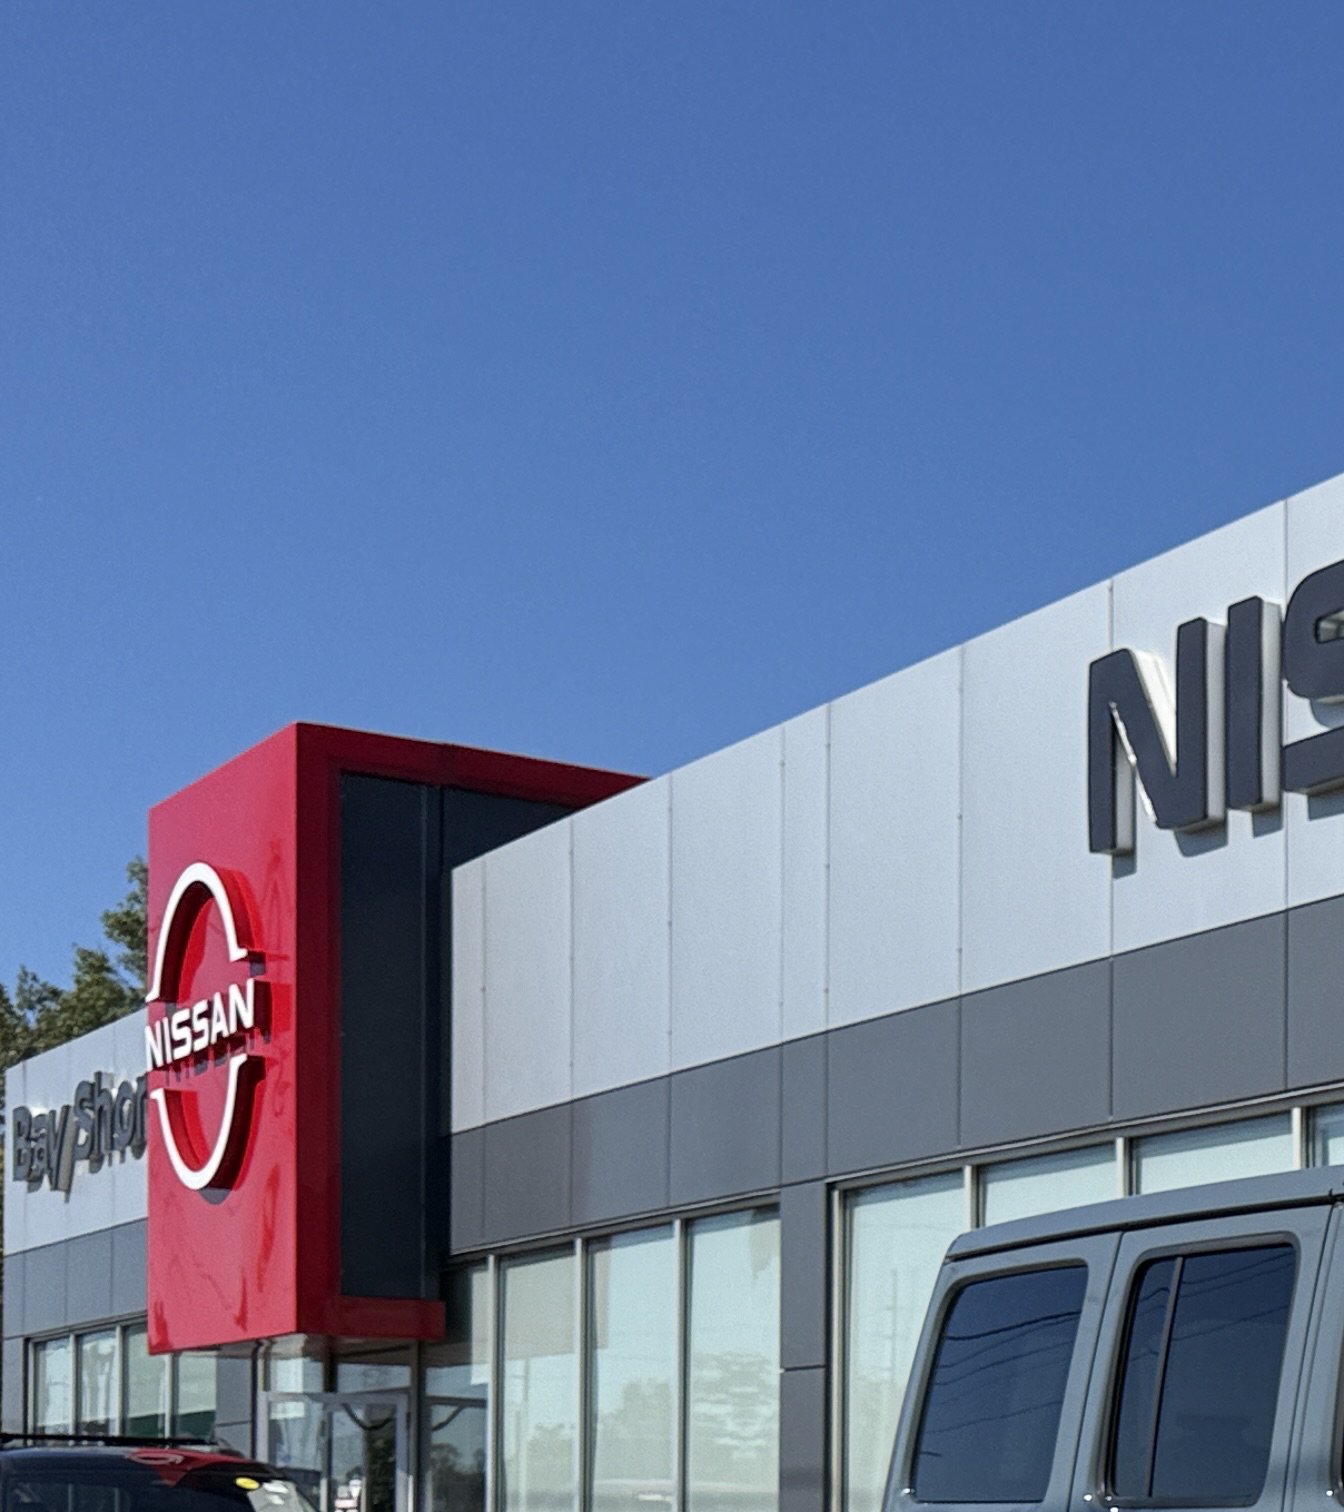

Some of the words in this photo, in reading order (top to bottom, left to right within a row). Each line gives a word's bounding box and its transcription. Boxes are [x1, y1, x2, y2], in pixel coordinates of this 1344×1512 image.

[145, 977, 256, 1072] NISSAN
[12, 1104, 72, 1192] Bay
[73, 1070, 148, 1162] Shor
